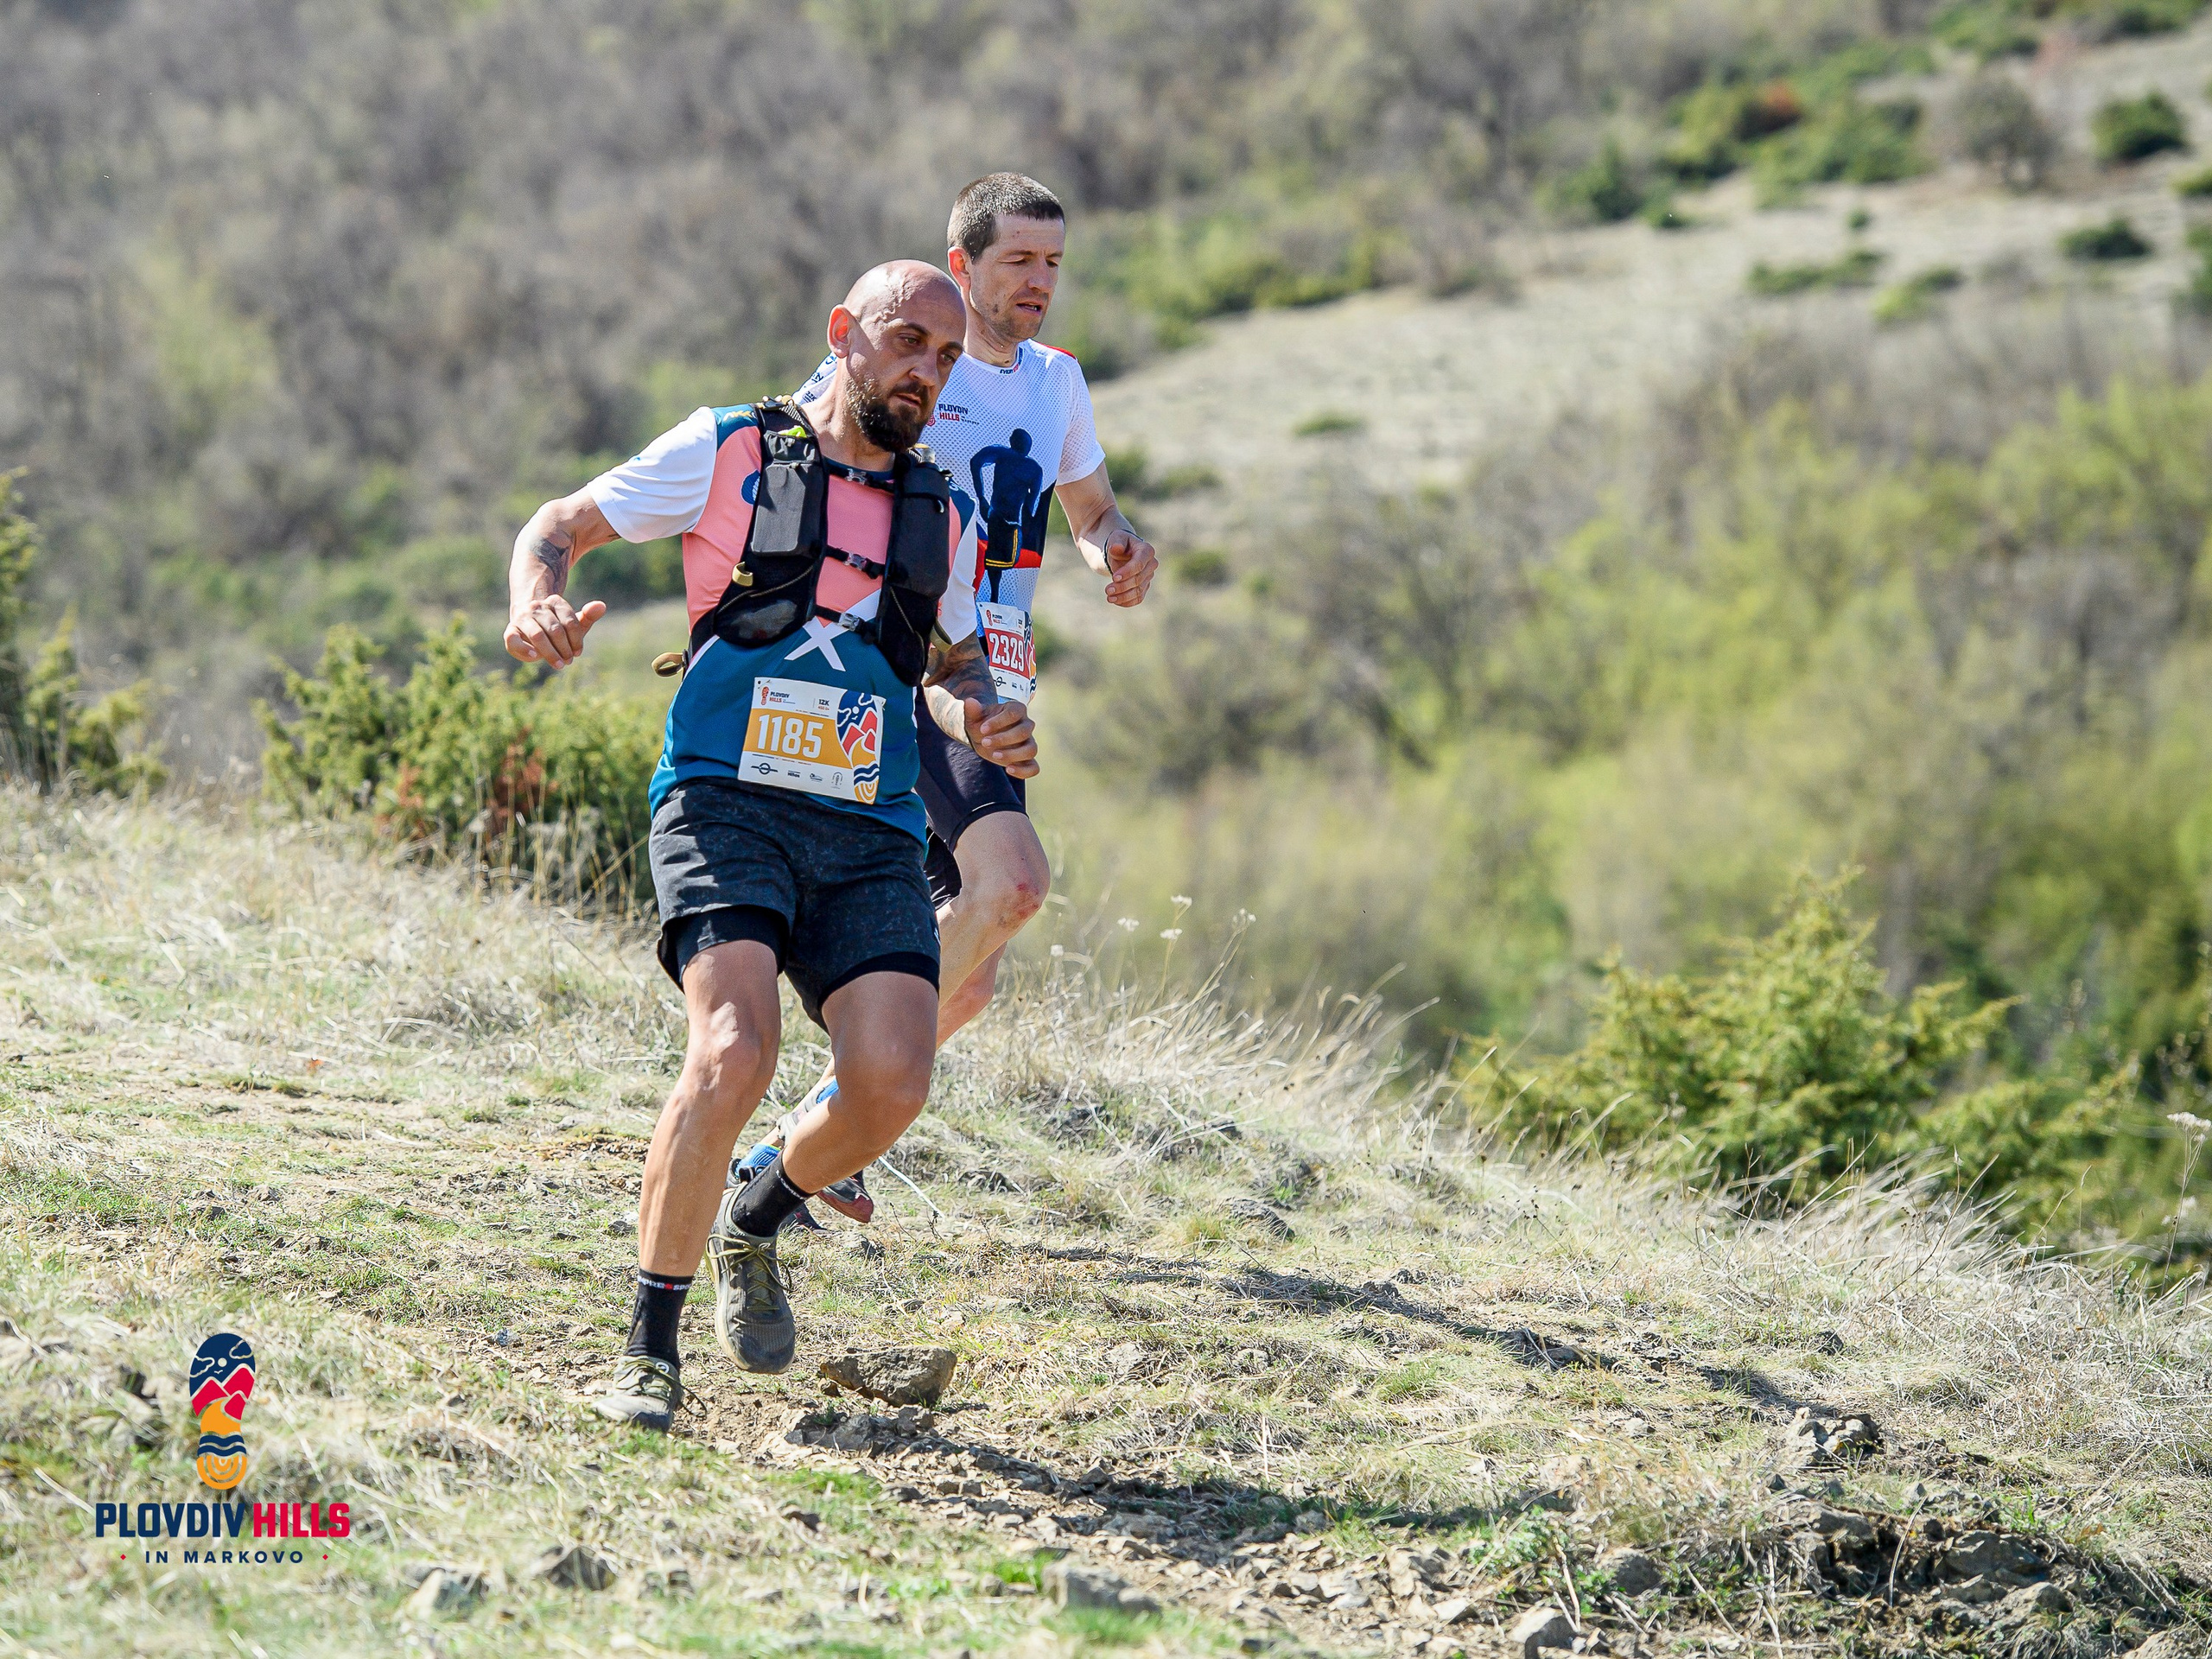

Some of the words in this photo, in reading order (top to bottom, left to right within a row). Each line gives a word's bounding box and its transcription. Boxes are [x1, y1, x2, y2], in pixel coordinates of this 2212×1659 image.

[938, 404, 969, 415] PLOVDIV
[939, 412, 960, 422] HILLS
[989, 632, 1024, 672] 2329
[758, 714, 823, 759] 1185
